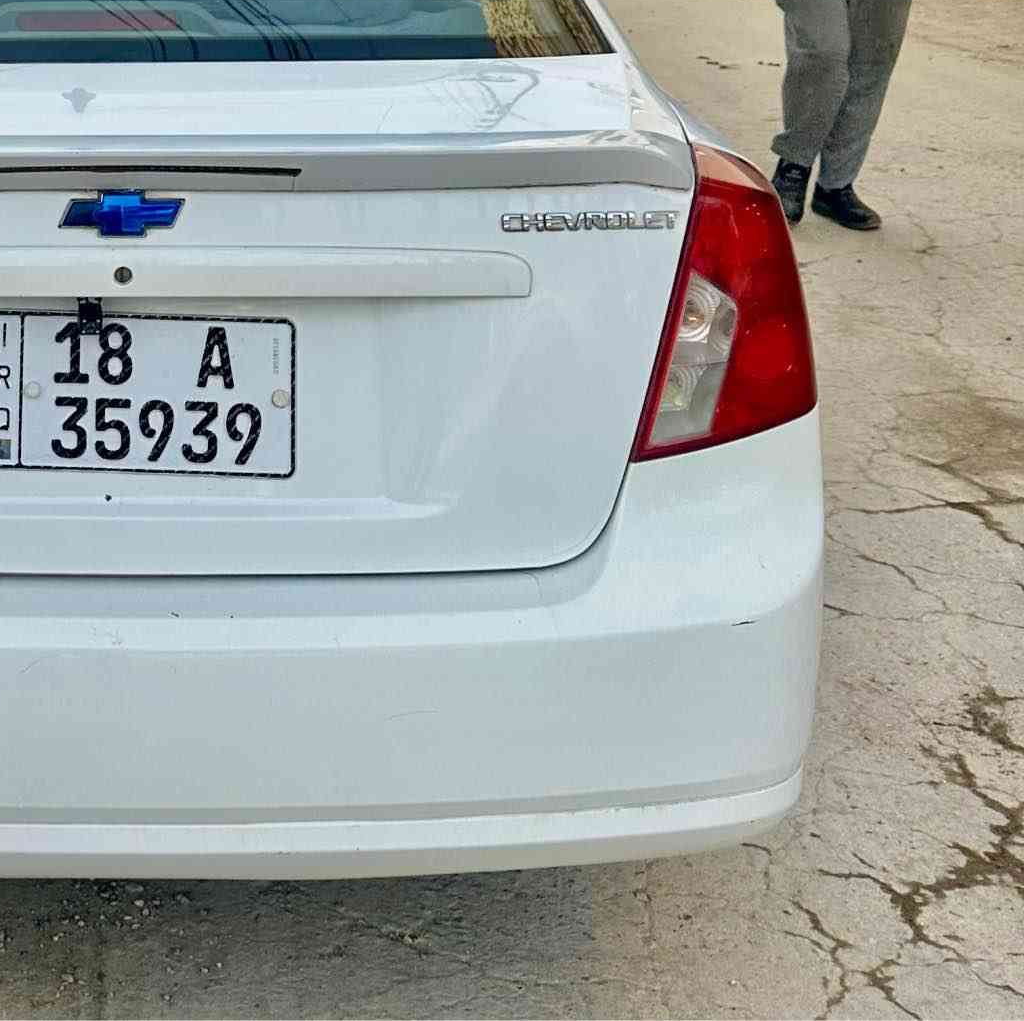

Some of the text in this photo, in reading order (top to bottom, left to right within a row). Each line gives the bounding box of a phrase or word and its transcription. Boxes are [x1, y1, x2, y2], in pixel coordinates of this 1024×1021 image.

[501, 210, 680, 232] CHEVROLET
[53, 321, 133, 385] 18
[196, 326, 235, 389] A
[51, 396, 262, 465] 35939
